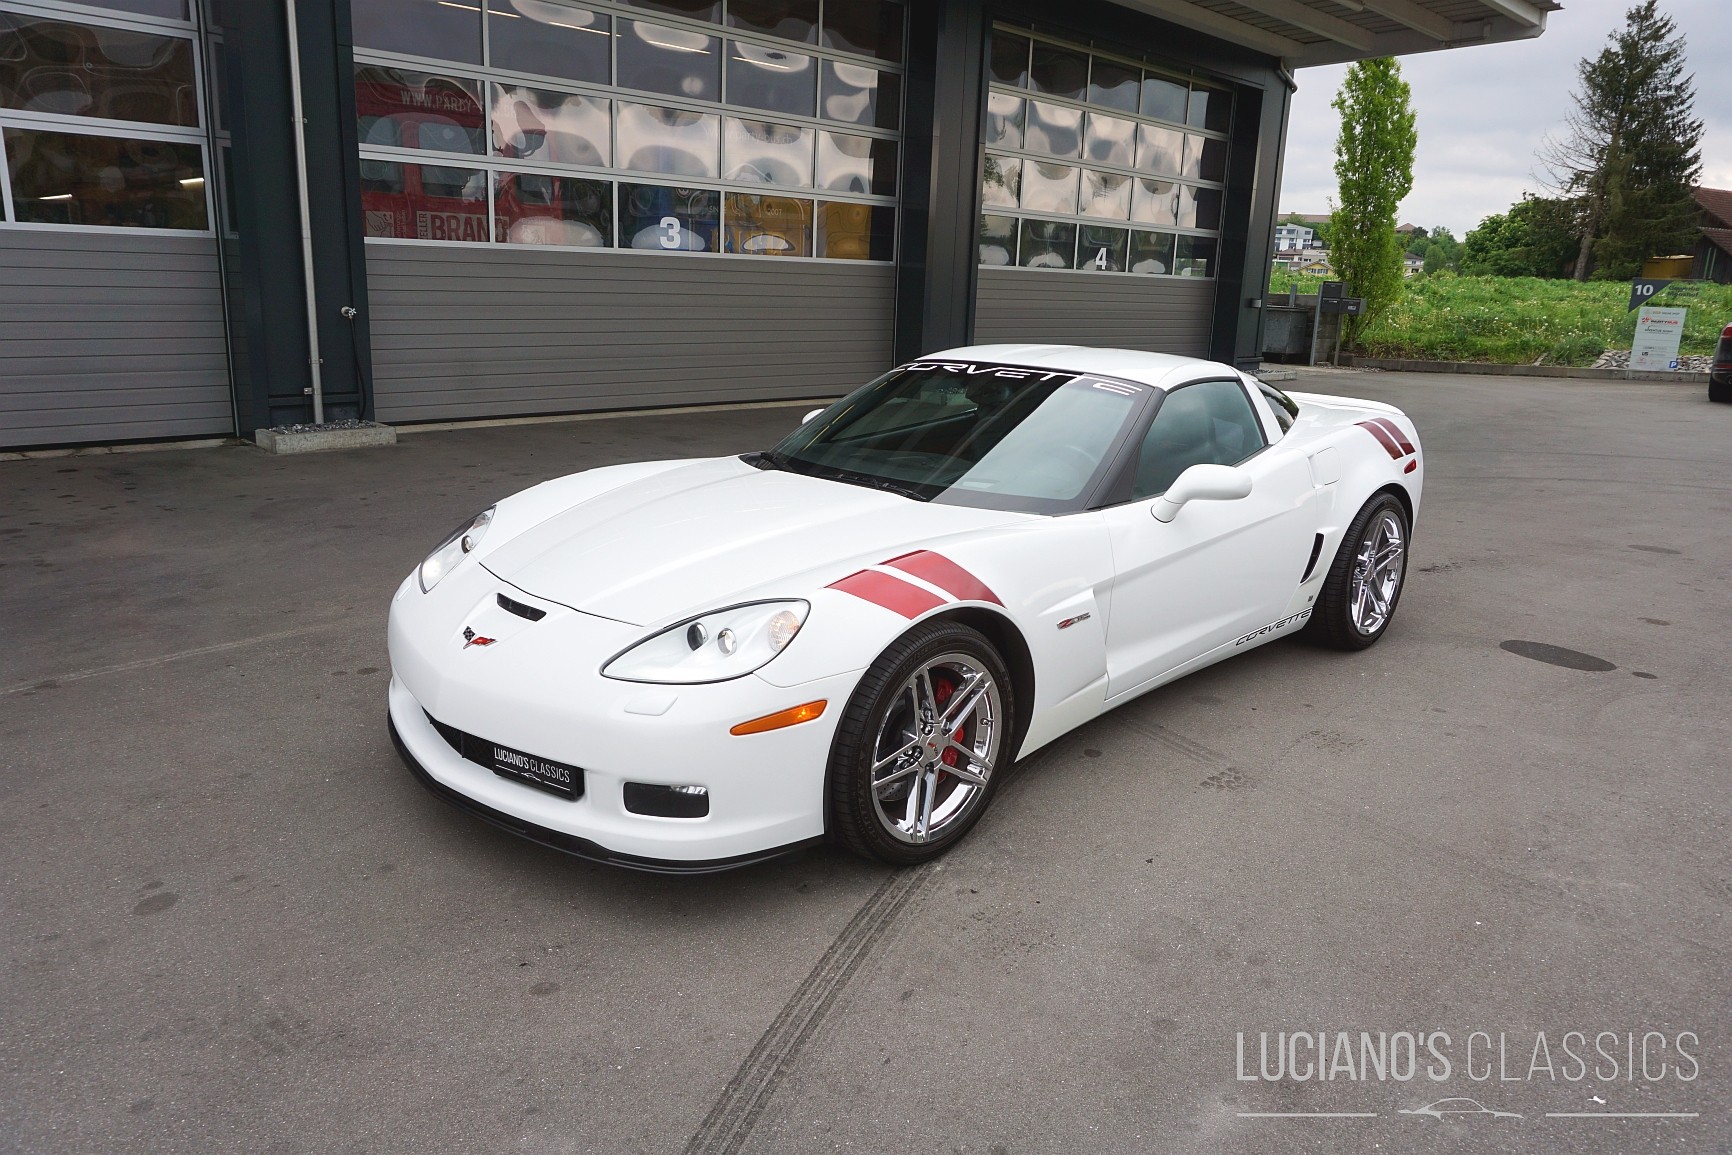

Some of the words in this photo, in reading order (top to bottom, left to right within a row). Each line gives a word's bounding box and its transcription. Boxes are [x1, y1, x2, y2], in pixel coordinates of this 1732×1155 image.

[418, 212, 428, 240] ELLER
[659, 216, 681, 249] 3
[1095, 247, 1107, 270] 4
[1635, 284, 1654, 296] 10
[1235, 608, 1313, 647] CORVETTE
[494, 747, 529, 769] LUCIANO'S
[530, 759, 570, 783] CLASSICS
